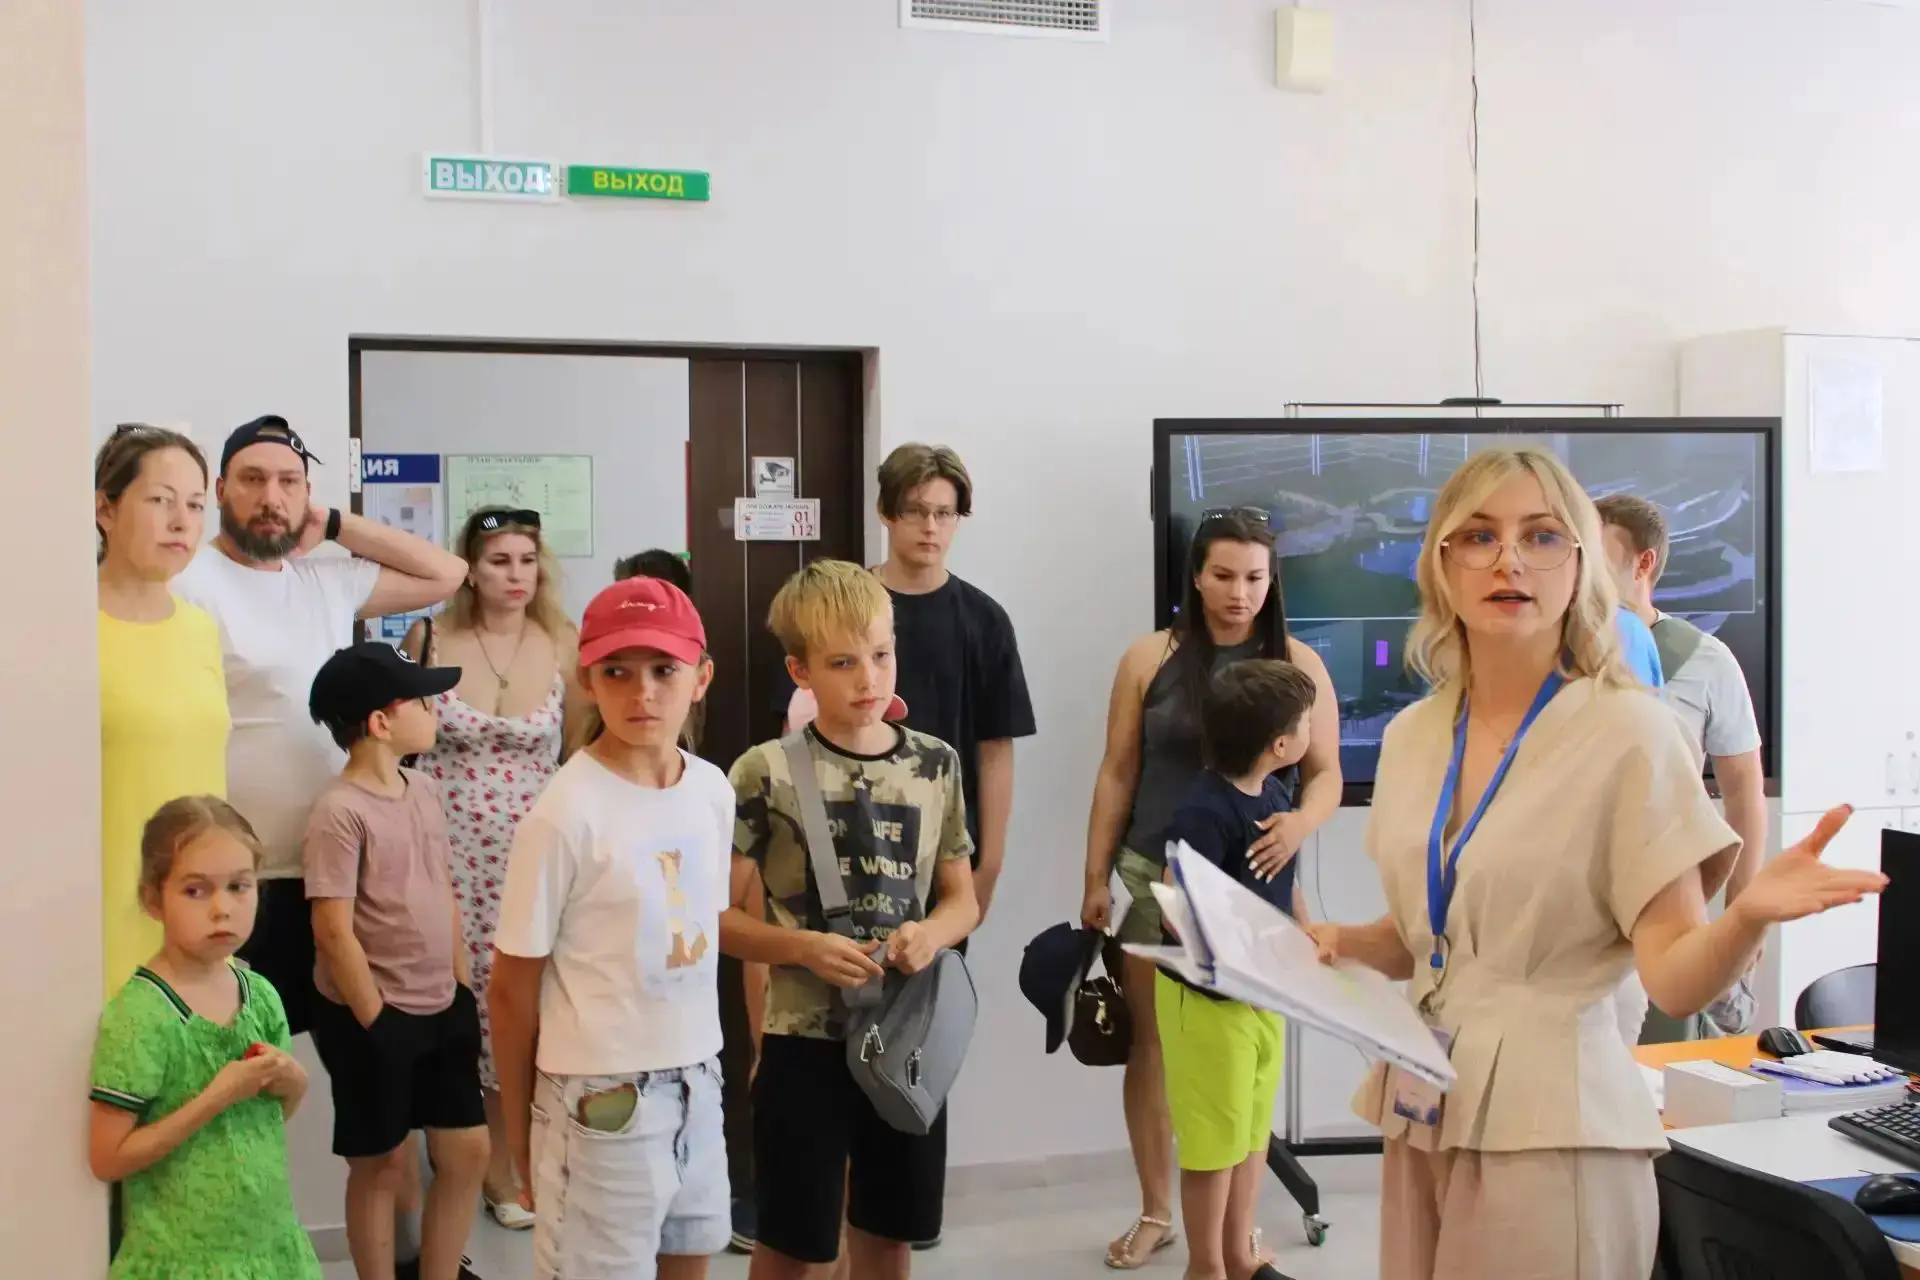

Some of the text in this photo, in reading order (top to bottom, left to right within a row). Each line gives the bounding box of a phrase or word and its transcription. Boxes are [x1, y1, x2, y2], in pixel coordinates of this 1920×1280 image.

[435, 160, 545, 193] ВЫХОД
[592, 170, 684, 196] ВЫХОД
[794, 511, 809, 524] 01
[791, 524, 813, 537] 112
[839, 856, 851, 876] E
